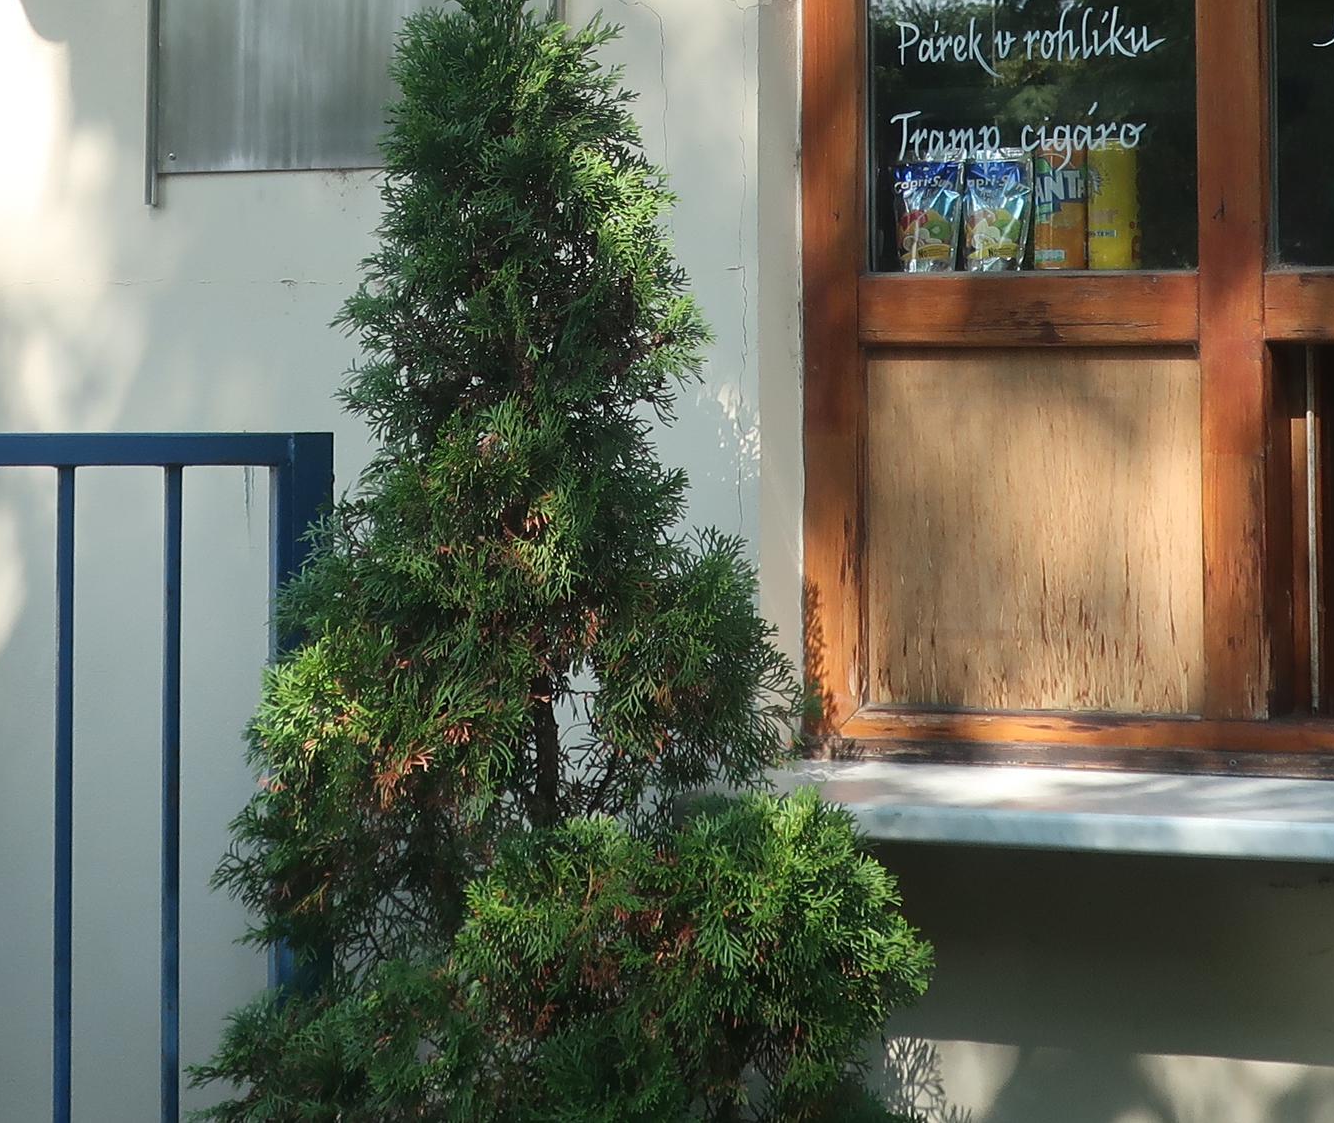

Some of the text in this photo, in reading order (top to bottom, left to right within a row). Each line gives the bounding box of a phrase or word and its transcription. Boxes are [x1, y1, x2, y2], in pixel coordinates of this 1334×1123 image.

[895, 5, 1167, 78] Párek v rohlíku
[890, 101, 1147, 171] Tramp cigáro
